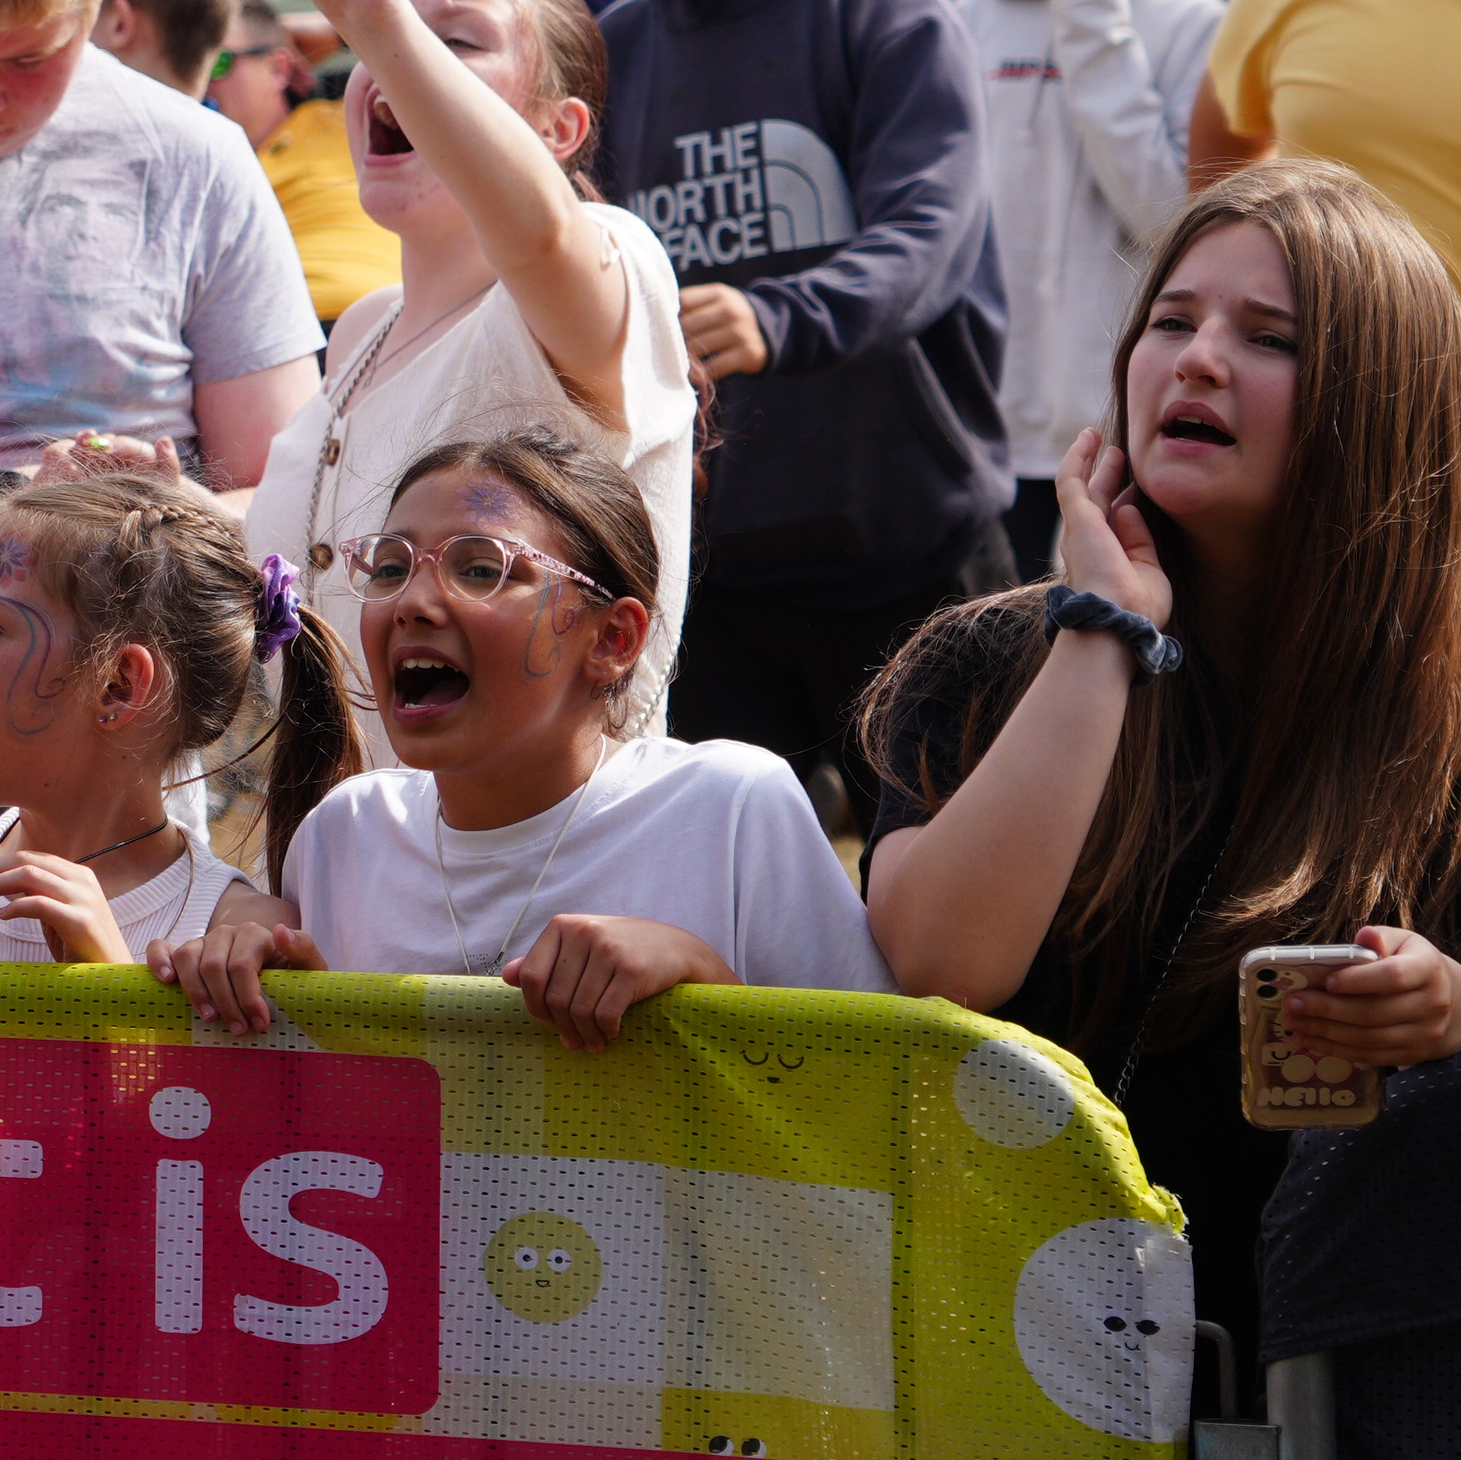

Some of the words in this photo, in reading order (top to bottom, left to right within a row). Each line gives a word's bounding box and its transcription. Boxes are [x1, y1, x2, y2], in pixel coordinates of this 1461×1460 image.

[674, 120, 760, 178] THE
[662, 211, 768, 272] FACE
[148, 1086, 389, 1345] is
